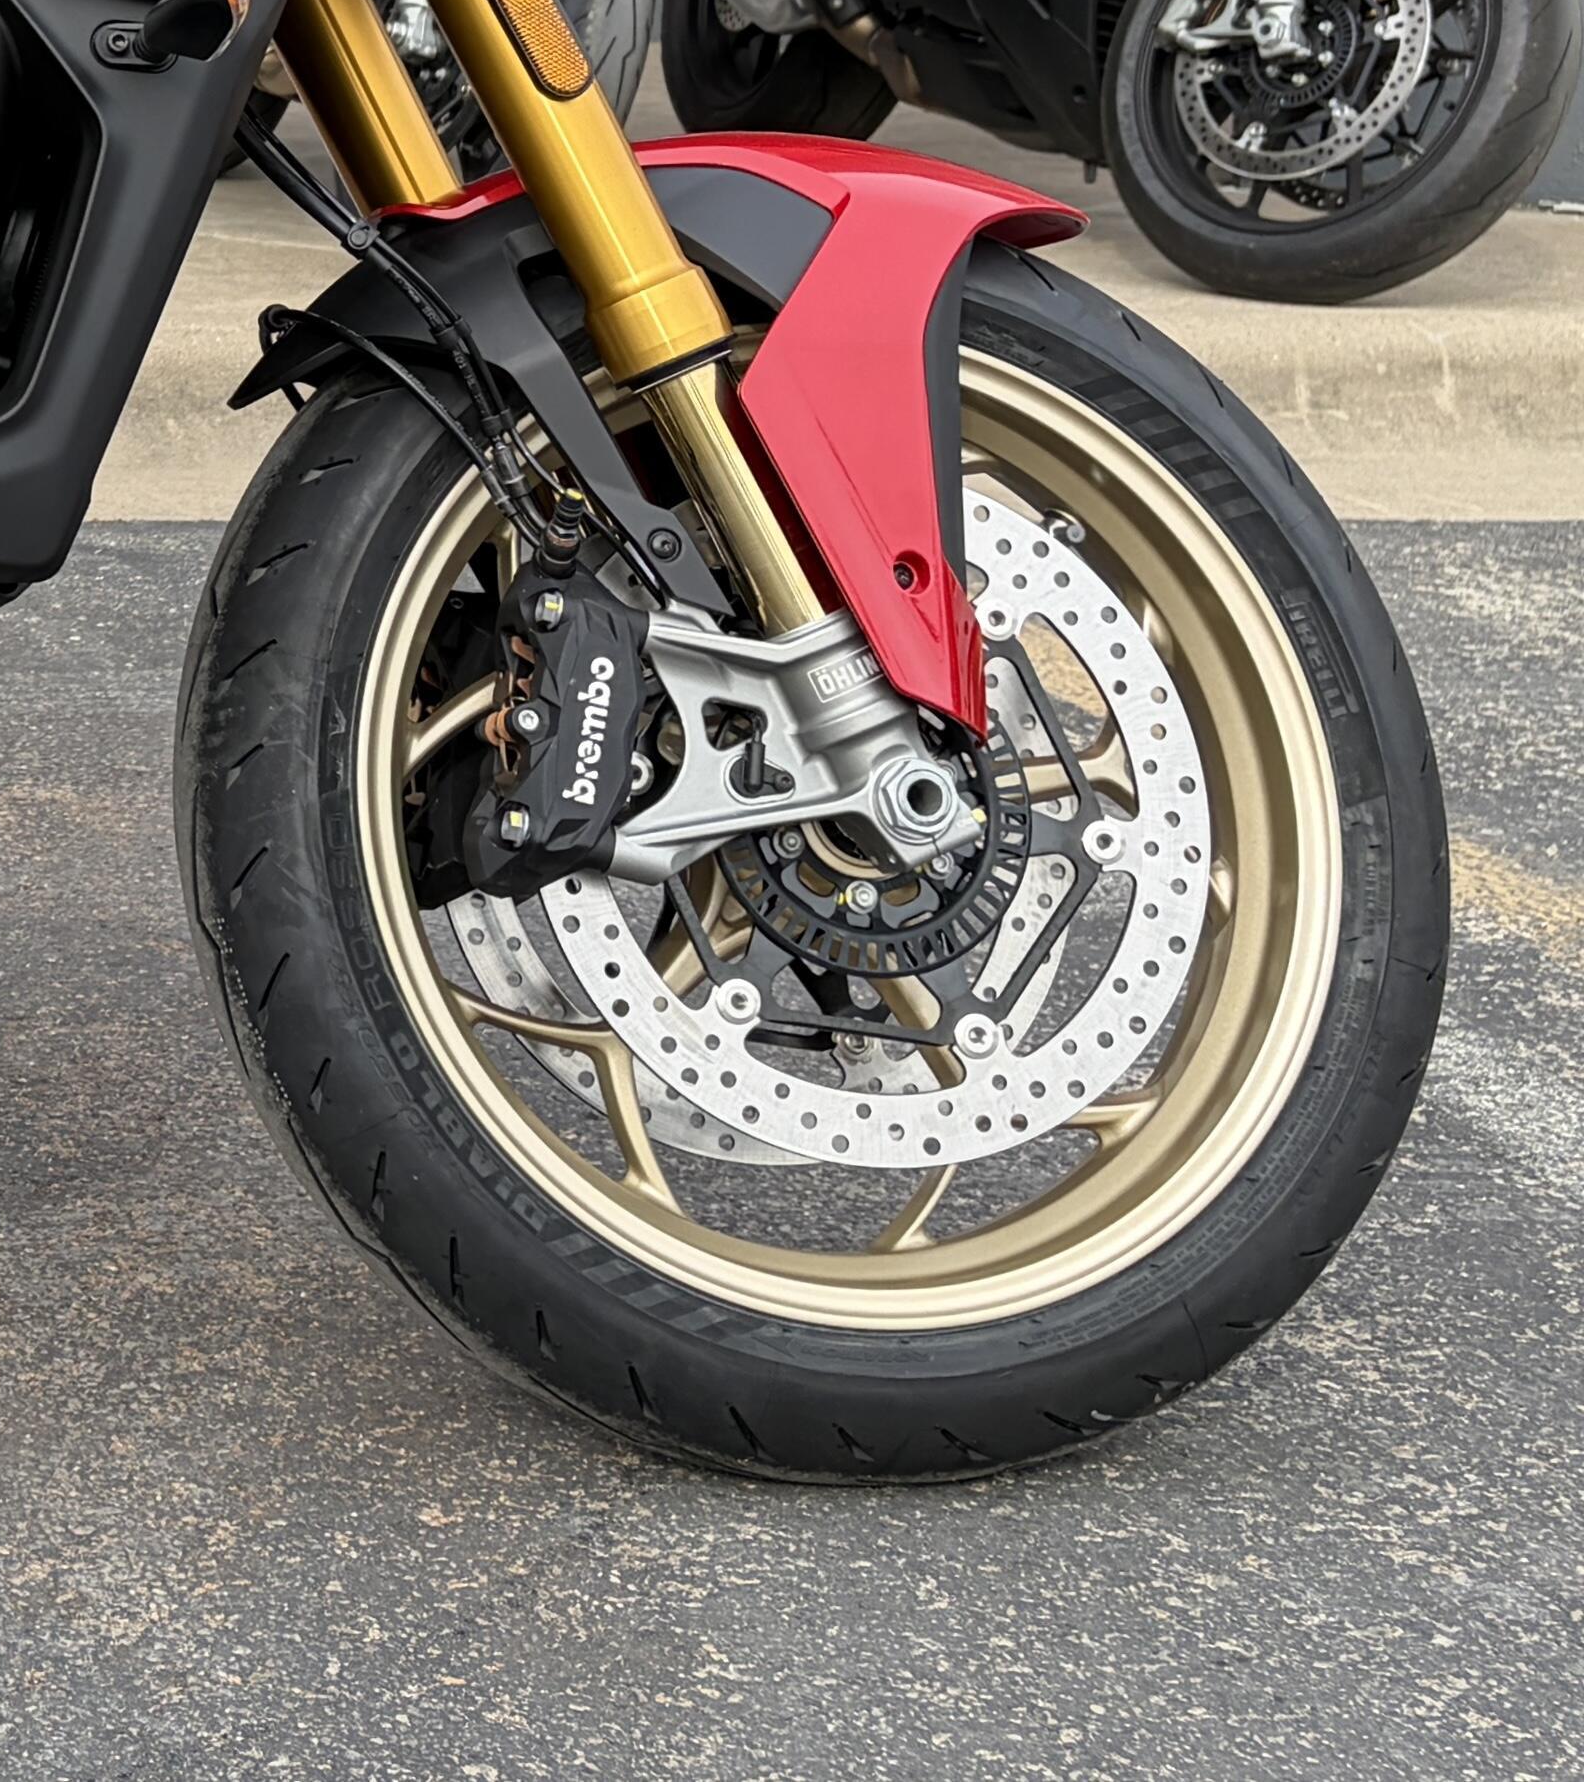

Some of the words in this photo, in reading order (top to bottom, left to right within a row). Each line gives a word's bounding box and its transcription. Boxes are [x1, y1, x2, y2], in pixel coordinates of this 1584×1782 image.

[814, 648, 881, 695] ÖHLIN
[1280, 587, 1359, 718] PIRELLI
[562, 656, 615, 805] brembo
[385, 1026, 551, 1232] DIABLO
